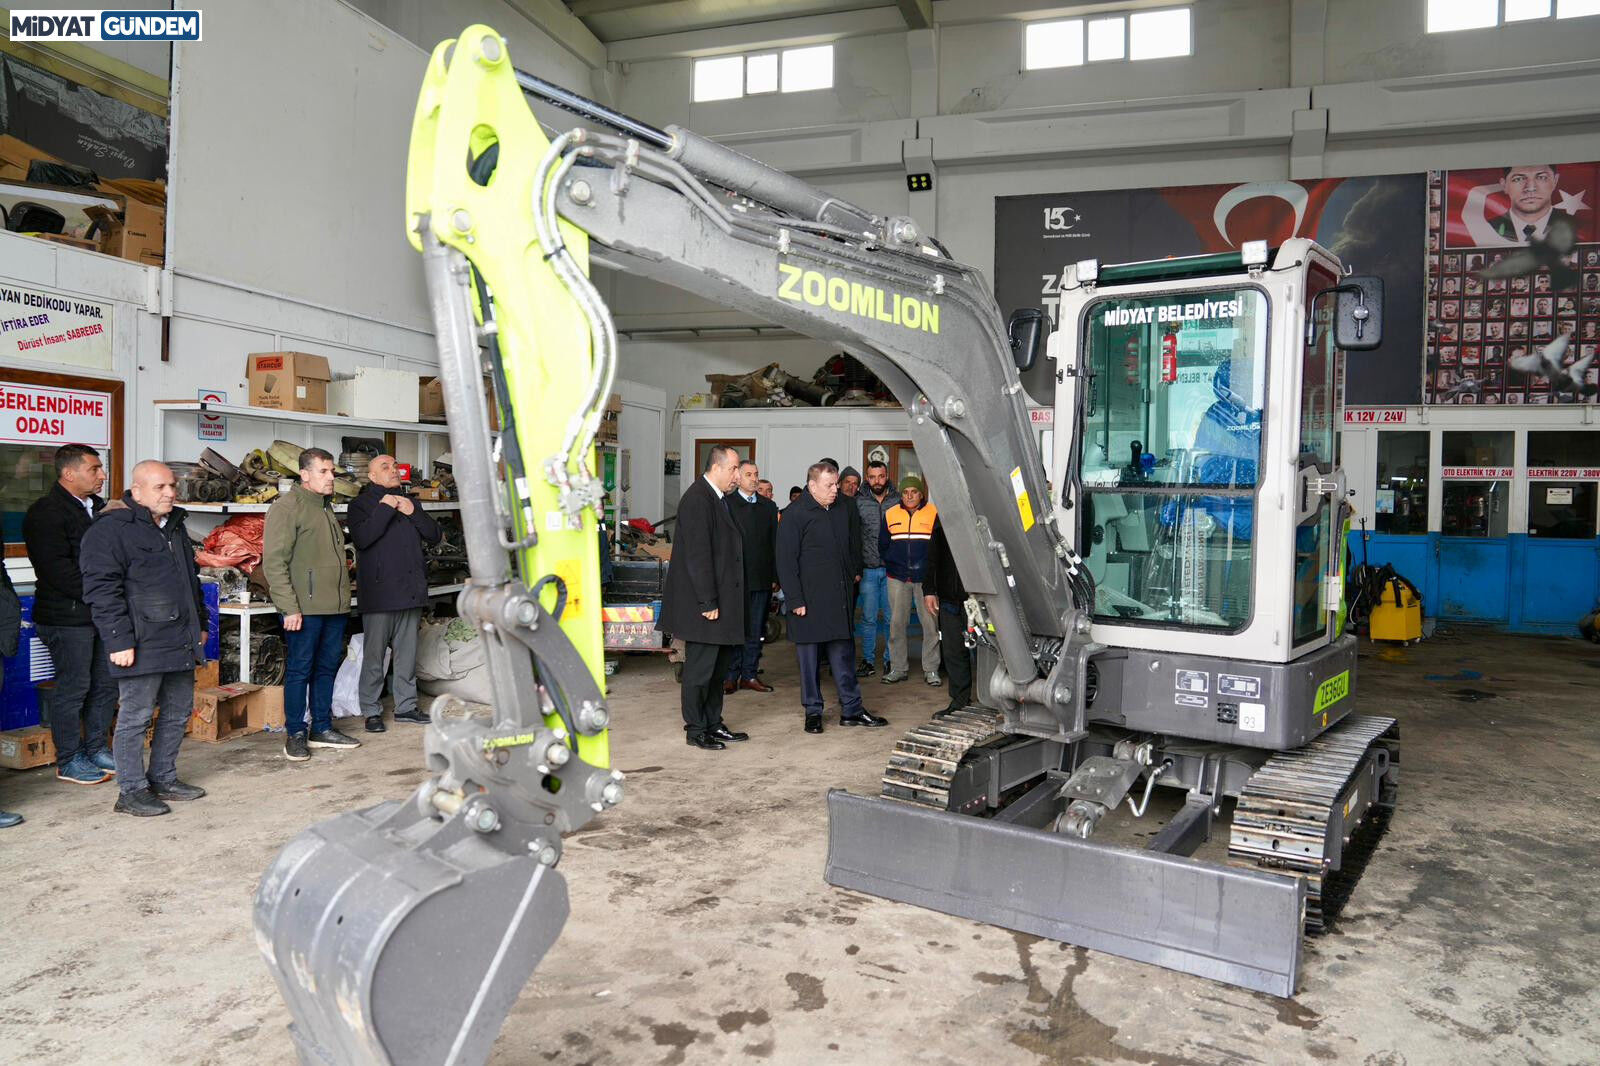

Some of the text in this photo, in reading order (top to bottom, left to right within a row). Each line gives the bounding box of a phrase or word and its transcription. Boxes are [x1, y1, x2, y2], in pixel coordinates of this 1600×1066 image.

[0, 288, 103, 319] YAN DEDİKODU YAPAR.
[778, 263, 939, 335] ZOOMLION
[28, 313, 50, 327] EDER
[1104, 296, 1243, 327] MİDYAT BELEDİYESİ
[17, 339, 44, 351] Dürüst
[66, 323, 104, 341] SABREDER
[16, 416, 65, 436] ODASI
[1357, 411, 1375, 421] 12V
[1377, 411, 1381, 423] /
[1384, 411, 1403, 421] 24V
[1443, 468, 1455, 477] OTO
[1456, 467, 1483, 477] ELEKTRİK
[1485, 468, 1496, 477] 12V
[1501, 469, 1513, 477] 24V
[1528, 468, 1559, 478] ELEKTRİK
[1560, 468, 1577, 477] 220V
